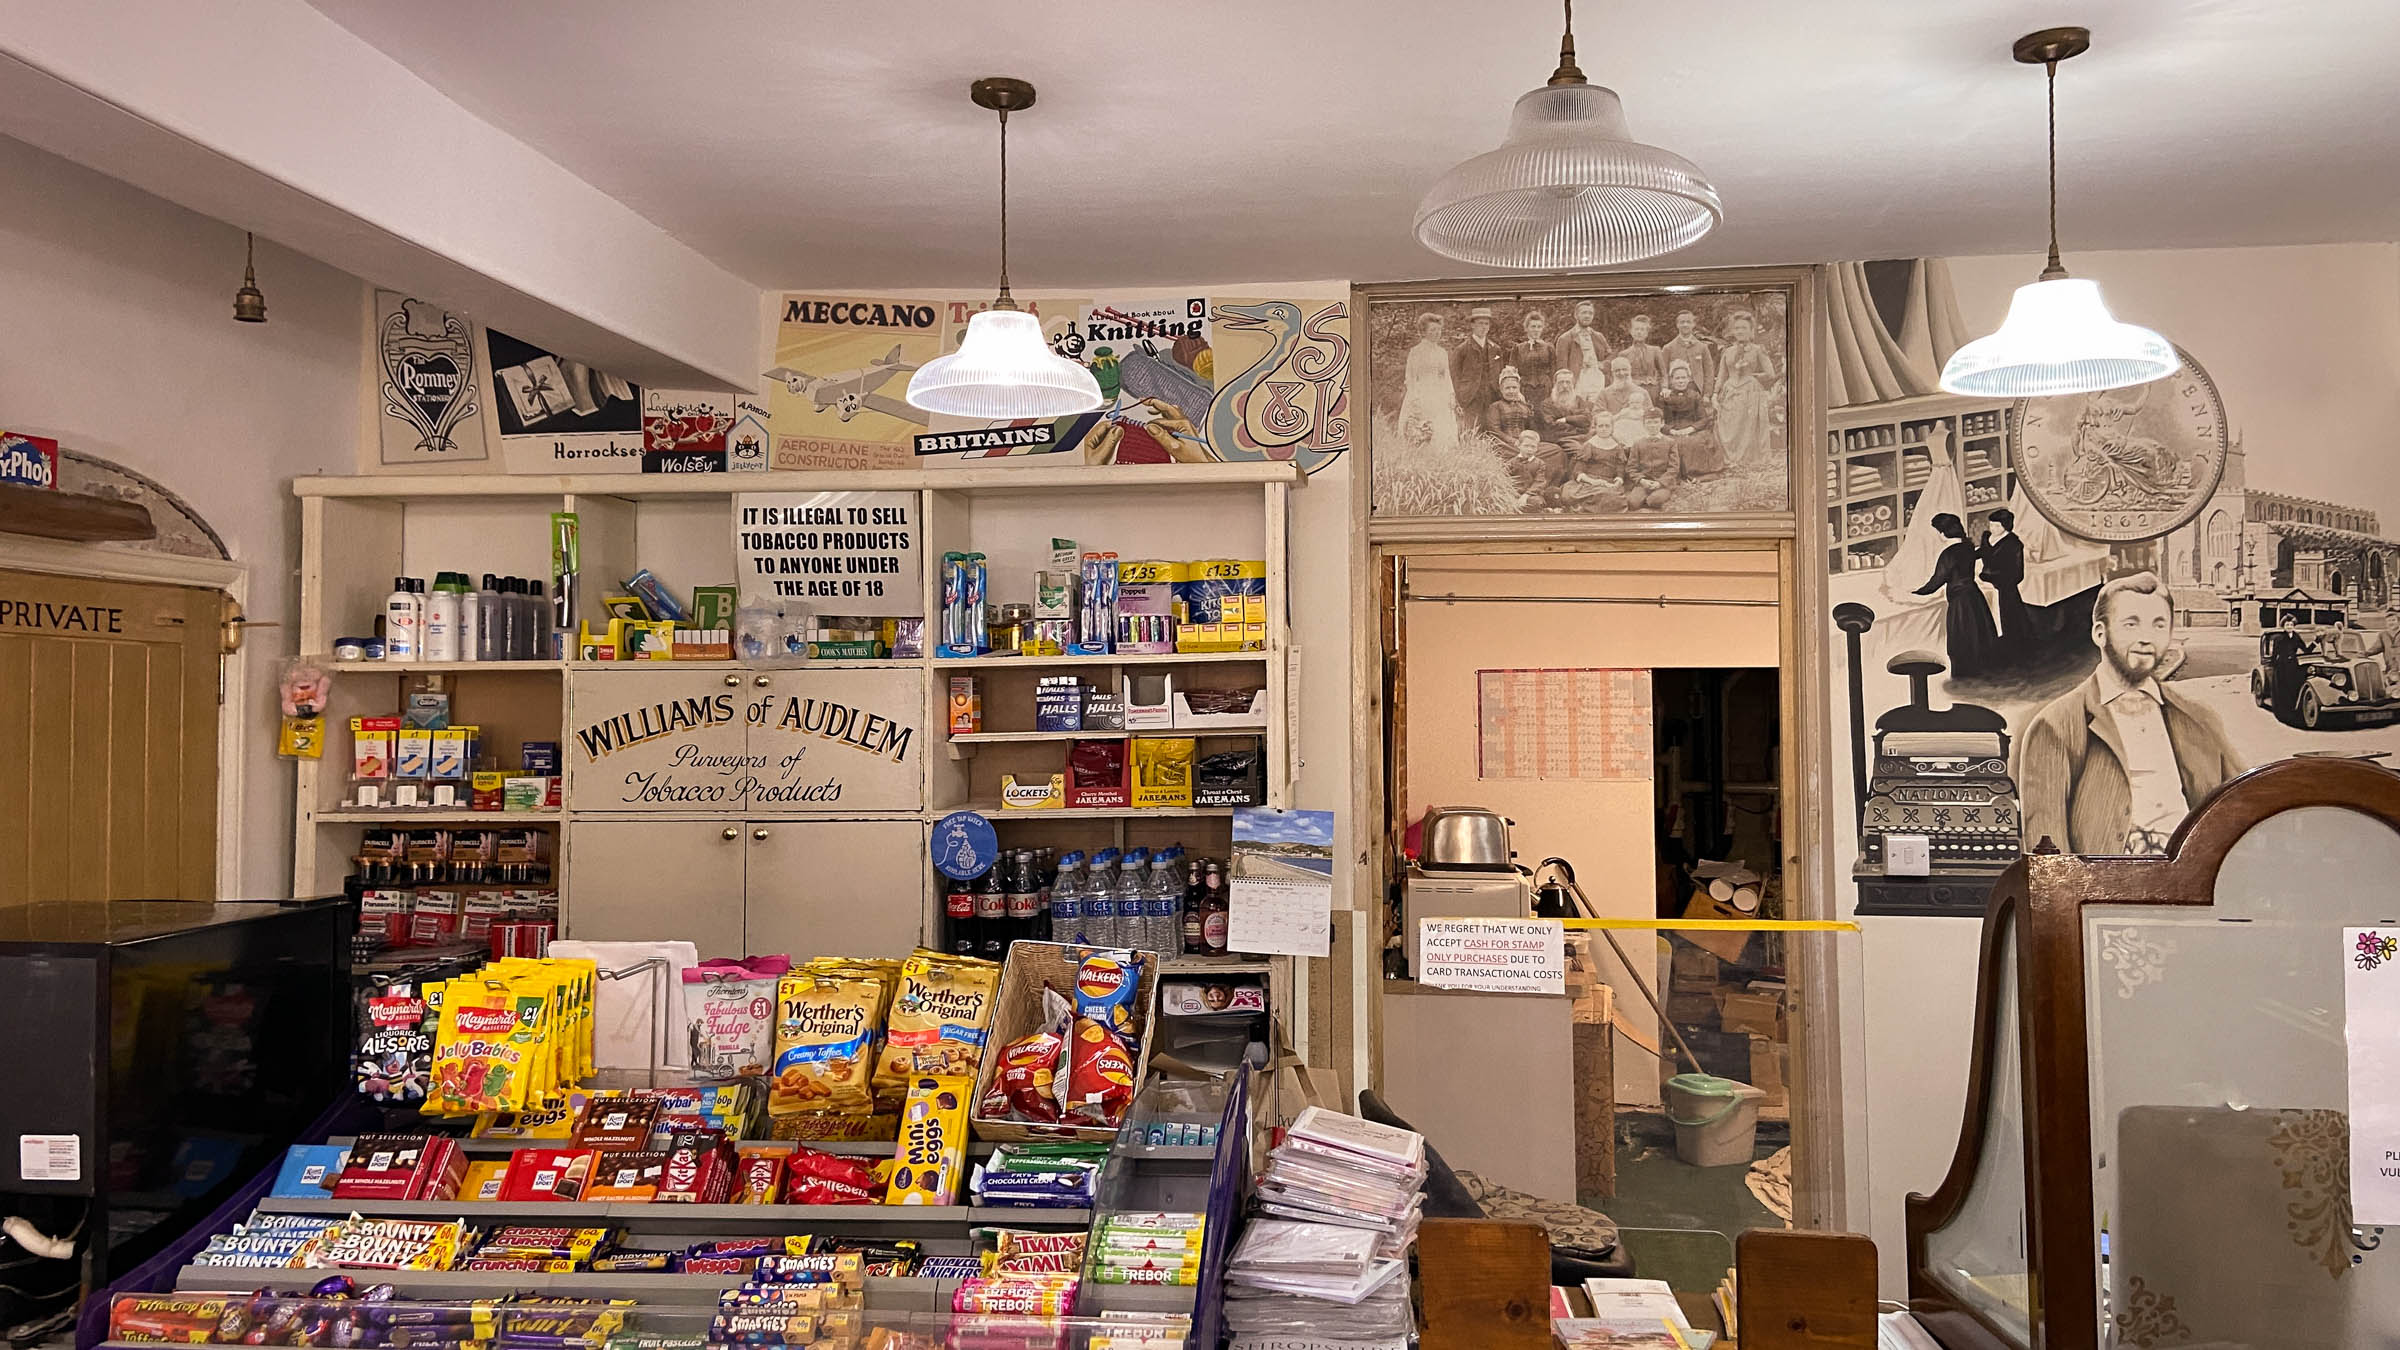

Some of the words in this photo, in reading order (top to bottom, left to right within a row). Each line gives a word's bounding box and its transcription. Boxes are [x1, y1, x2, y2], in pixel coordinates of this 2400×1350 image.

[783, 300, 935, 328] MECCANO
[1087, 319, 1203, 341] Knitting
[403, 362, 459, 394] Romney
[919, 428, 1050, 451] BRITAINS
[554, 442, 646, 461] Horrockses
[780, 440, 869, 456] AEROPLANE
[661, 456, 714, 472] Wolsey
[778, 453, 868, 470] CONSTRUCTOR
[743, 508, 758, 525] IT
[762, 508, 778, 525] IS
[783, 508, 843, 525] ILLEGAL
[847, 508, 868, 525] TO
[872, 507, 907, 525] SELL
[2090, 513, 2149, 529] 1862
[741, 532, 818, 550] TOBACCO
[823, 532, 909, 550] PRODUCTS
[754, 557, 775, 574] TO
[780, 557, 842, 574] ANYONE
[846, 557, 899, 573] UNDER
[1121, 566, 1156, 579] £1.35
[1206, 564, 1240, 577] £1.35
[774, 581, 804, 596] THE
[808, 581, 838, 596] AGE
[842, 580, 862, 596] OF
[865, 580, 884, 596] 18
[0, 600, 123, 633] PRIVATE
[842, 648, 868, 656] MATCHES
[1040, 705, 1078, 715] HALLS
[1086, 704, 1124, 714] HALLS
[577, 695, 734, 763] WILLIAMS
[746, 695, 774, 724] of
[780, 697, 914, 763] AUDLEM
[668, 744, 766, 775] Purveyors
[781, 747, 806, 779] of
[622, 772, 725, 802] Tobacco
[730, 777, 842, 802] Products
[1006, 788, 1049, 798] LOCKETS
[1898, 788, 1988, 801] NATIONAL
[1076, 796, 1124, 804] JAKEMANS
[1195, 795, 1250, 804] JAKEMANS
[943, 816, 957, 829] FREE
[957, 815, 967, 823] TAP
[967, 815, 984, 827] WATER
[363, 901, 398, 909] Panasonic
[466, 901, 500, 909] Panasonic
[1008, 897, 1037, 911] Coke
[1054, 903, 1073, 913] ICE
[1089, 901, 1109, 911] ICE
[1120, 901, 1140, 912] ICE
[1150, 902, 1168, 911] ICE
[1427, 924, 1442, 932] WE
[1445, 924, 1479, 933] REGRET
[1482, 925, 1506, 934] THAT
[1509, 926, 1524, 934] WE
[1527, 926, 1552, 935] ONLY
[1427, 939, 1461, 947] ACCEPT
[1464, 939, 1488, 948] CASH
[1491, 940, 1509, 948] FOR
[1512, 941, 1544, 949] STAMP
[1427, 953, 1451, 962] ONLY
[1454, 953, 1508, 963] PURCHASES
[1510, 955, 1529, 964] DUE
[1532, 955, 1545, 964] TO
[905, 962, 919, 973] £1
[1427, 967, 1452, 976] CARD
[1455, 968, 1531, 979] TRANSACTIONAL
[1533, 970, 1563, 979] COSTS
[1080, 969, 1122, 984] WALKERS
[707, 984, 749, 998] Thorntons
[780, 983, 796, 994] £1
[906, 977, 983, 1006] Werther's
[429, 992, 443, 1005] £1
[368, 999, 424, 1020] Maynards
[704, 1001, 747, 1016] Fabulous
[753, 1003, 767, 1015] £1
[784, 1000, 864, 1022] Werther's
[919, 1001, 977, 1021] Original
[456, 1010, 519, 1029] Maynards
[800, 1018, 859, 1036] Original
[375, 1030, 417, 1039] LIQUORICE
[707, 1016, 750, 1042] Fudge
[943, 1028, 963, 1037] SUGAR
[964, 1031, 979, 1039] FREE
[361, 1035, 430, 1055] ALLSORTS
[1008, 1045, 1050, 1059] WALKERS
[788, 1049, 816, 1061] Creamy
[818, 1047, 842, 1058] Toffees
[717, 1095, 732, 1107] 60p
[520, 1109, 567, 1127] eggs
[723, 1123, 738, 1136] 60p
[907, 1122, 925, 1165] Mini
[926, 1118, 944, 1165] eggs
[670, 1150, 697, 1186] KitKat
[361, 1222, 437, 1241] BOUNTY
[504, 1228, 571, 1237] crunchie
[224, 1236, 305, 1253] BOUNTY
[345, 1234, 430, 1254] BOUNTY
[496, 1236, 563, 1247] crunchie
[716, 1239, 770, 1254] wispa
[1013, 1235, 1078, 1253] TWIX
[208, 1253, 291, 1268] BOUNTY
[329, 1247, 416, 1265] BOUNTY
[1001, 1254, 1070, 1272] TWIX
[470, 1260, 540, 1272] crunchie
[685, 1258, 742, 1274] wispa
[777, 1256, 836, 1274] SMARTIES
[917, 1266, 982, 1278] SNICKERS
[1122, 1269, 1172, 1281] TREBOR
[135, 1300, 169, 1312] Toffee
[171, 1302, 199, 1314] Crisp
[980, 1299, 1034, 1311] TREBOR
[728, 1316, 790, 1333] SMARTIES
[639, 1340, 661, 1348] FRUIT
